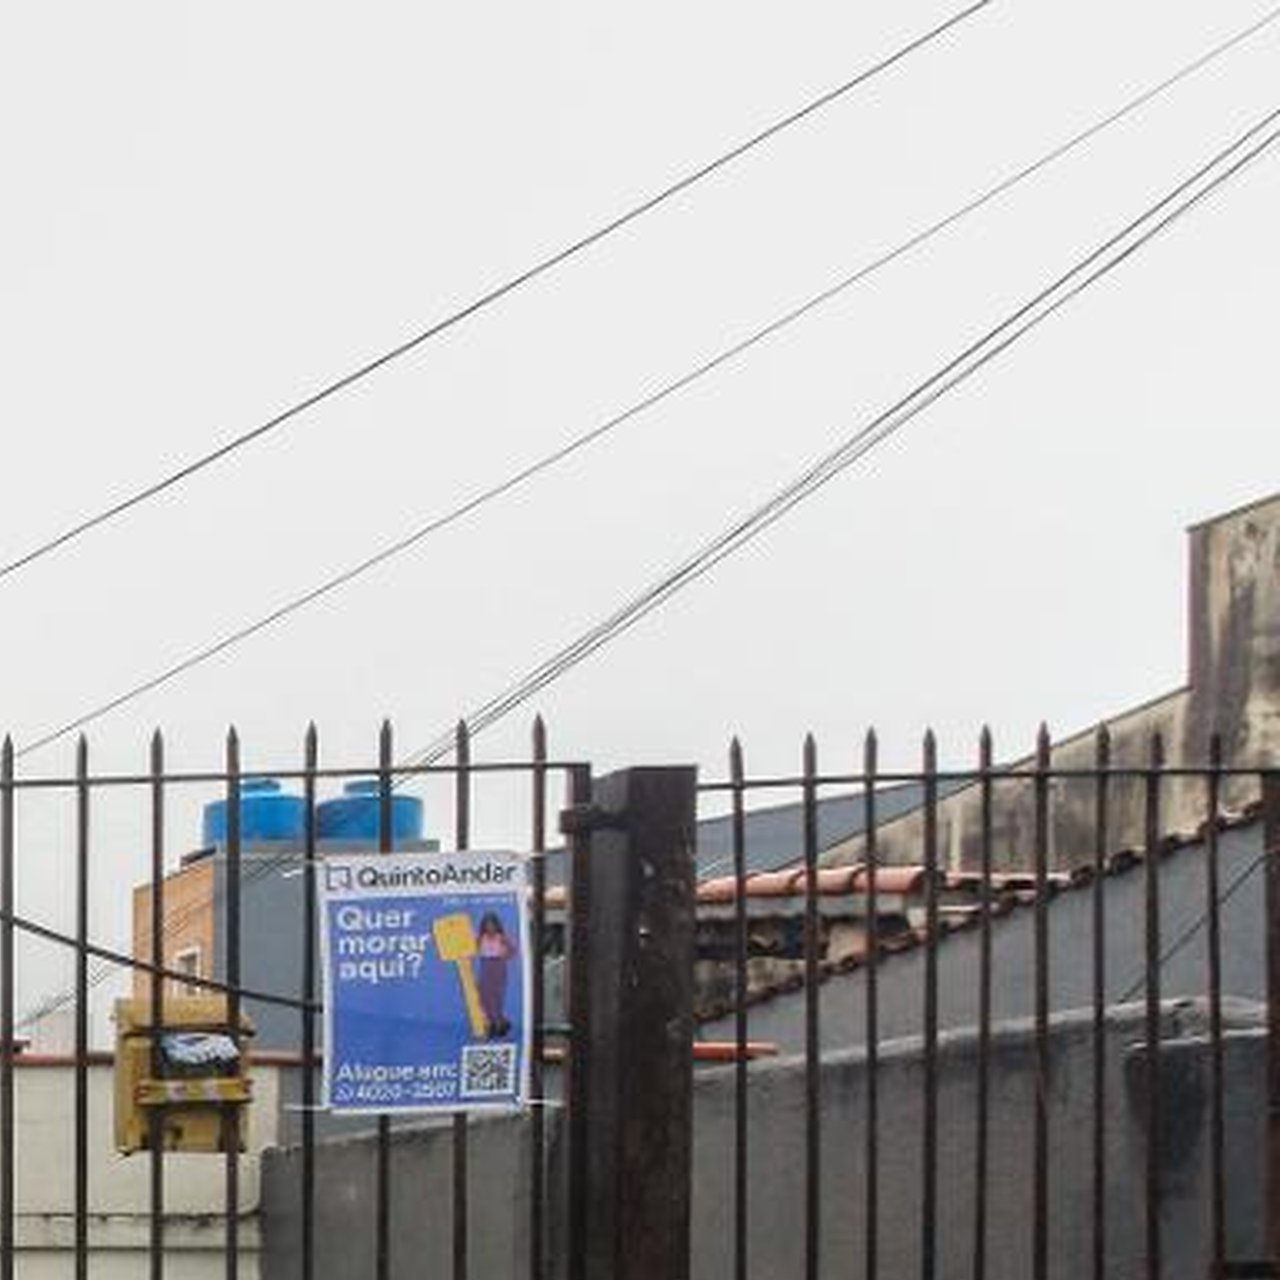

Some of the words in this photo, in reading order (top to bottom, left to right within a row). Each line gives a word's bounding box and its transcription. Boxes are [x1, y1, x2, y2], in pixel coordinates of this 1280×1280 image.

[357, 862, 517, 889] QuintoAndar
[338, 906, 412, 931] Quer
[339, 933, 431, 954] morar
[339, 953, 423, 984] aqui?
